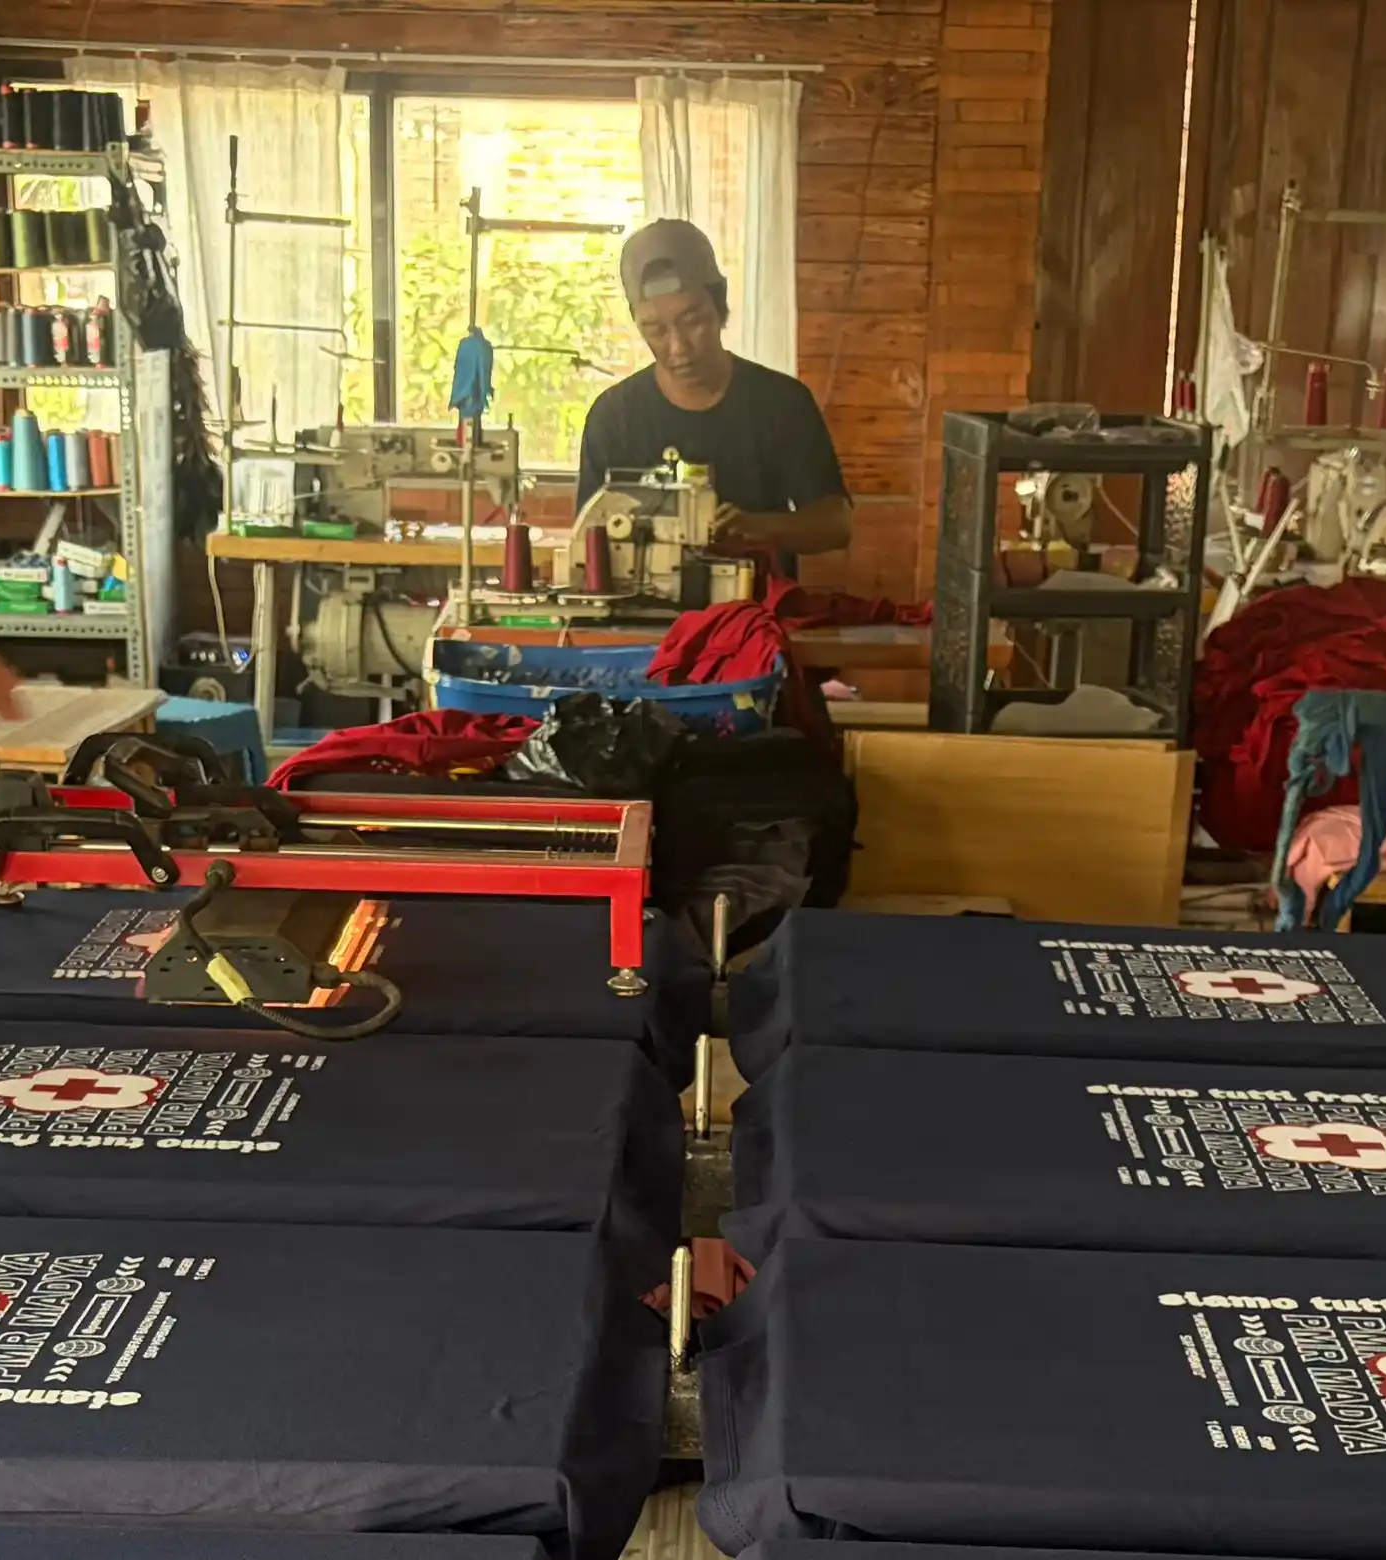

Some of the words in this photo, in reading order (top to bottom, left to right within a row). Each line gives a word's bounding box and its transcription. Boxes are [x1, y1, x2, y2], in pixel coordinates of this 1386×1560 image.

[8, 1253, 103, 1327] MADYA
[1159, 1291, 1299, 1309] siamo
[1281, 1314, 1348, 1362] PMR
